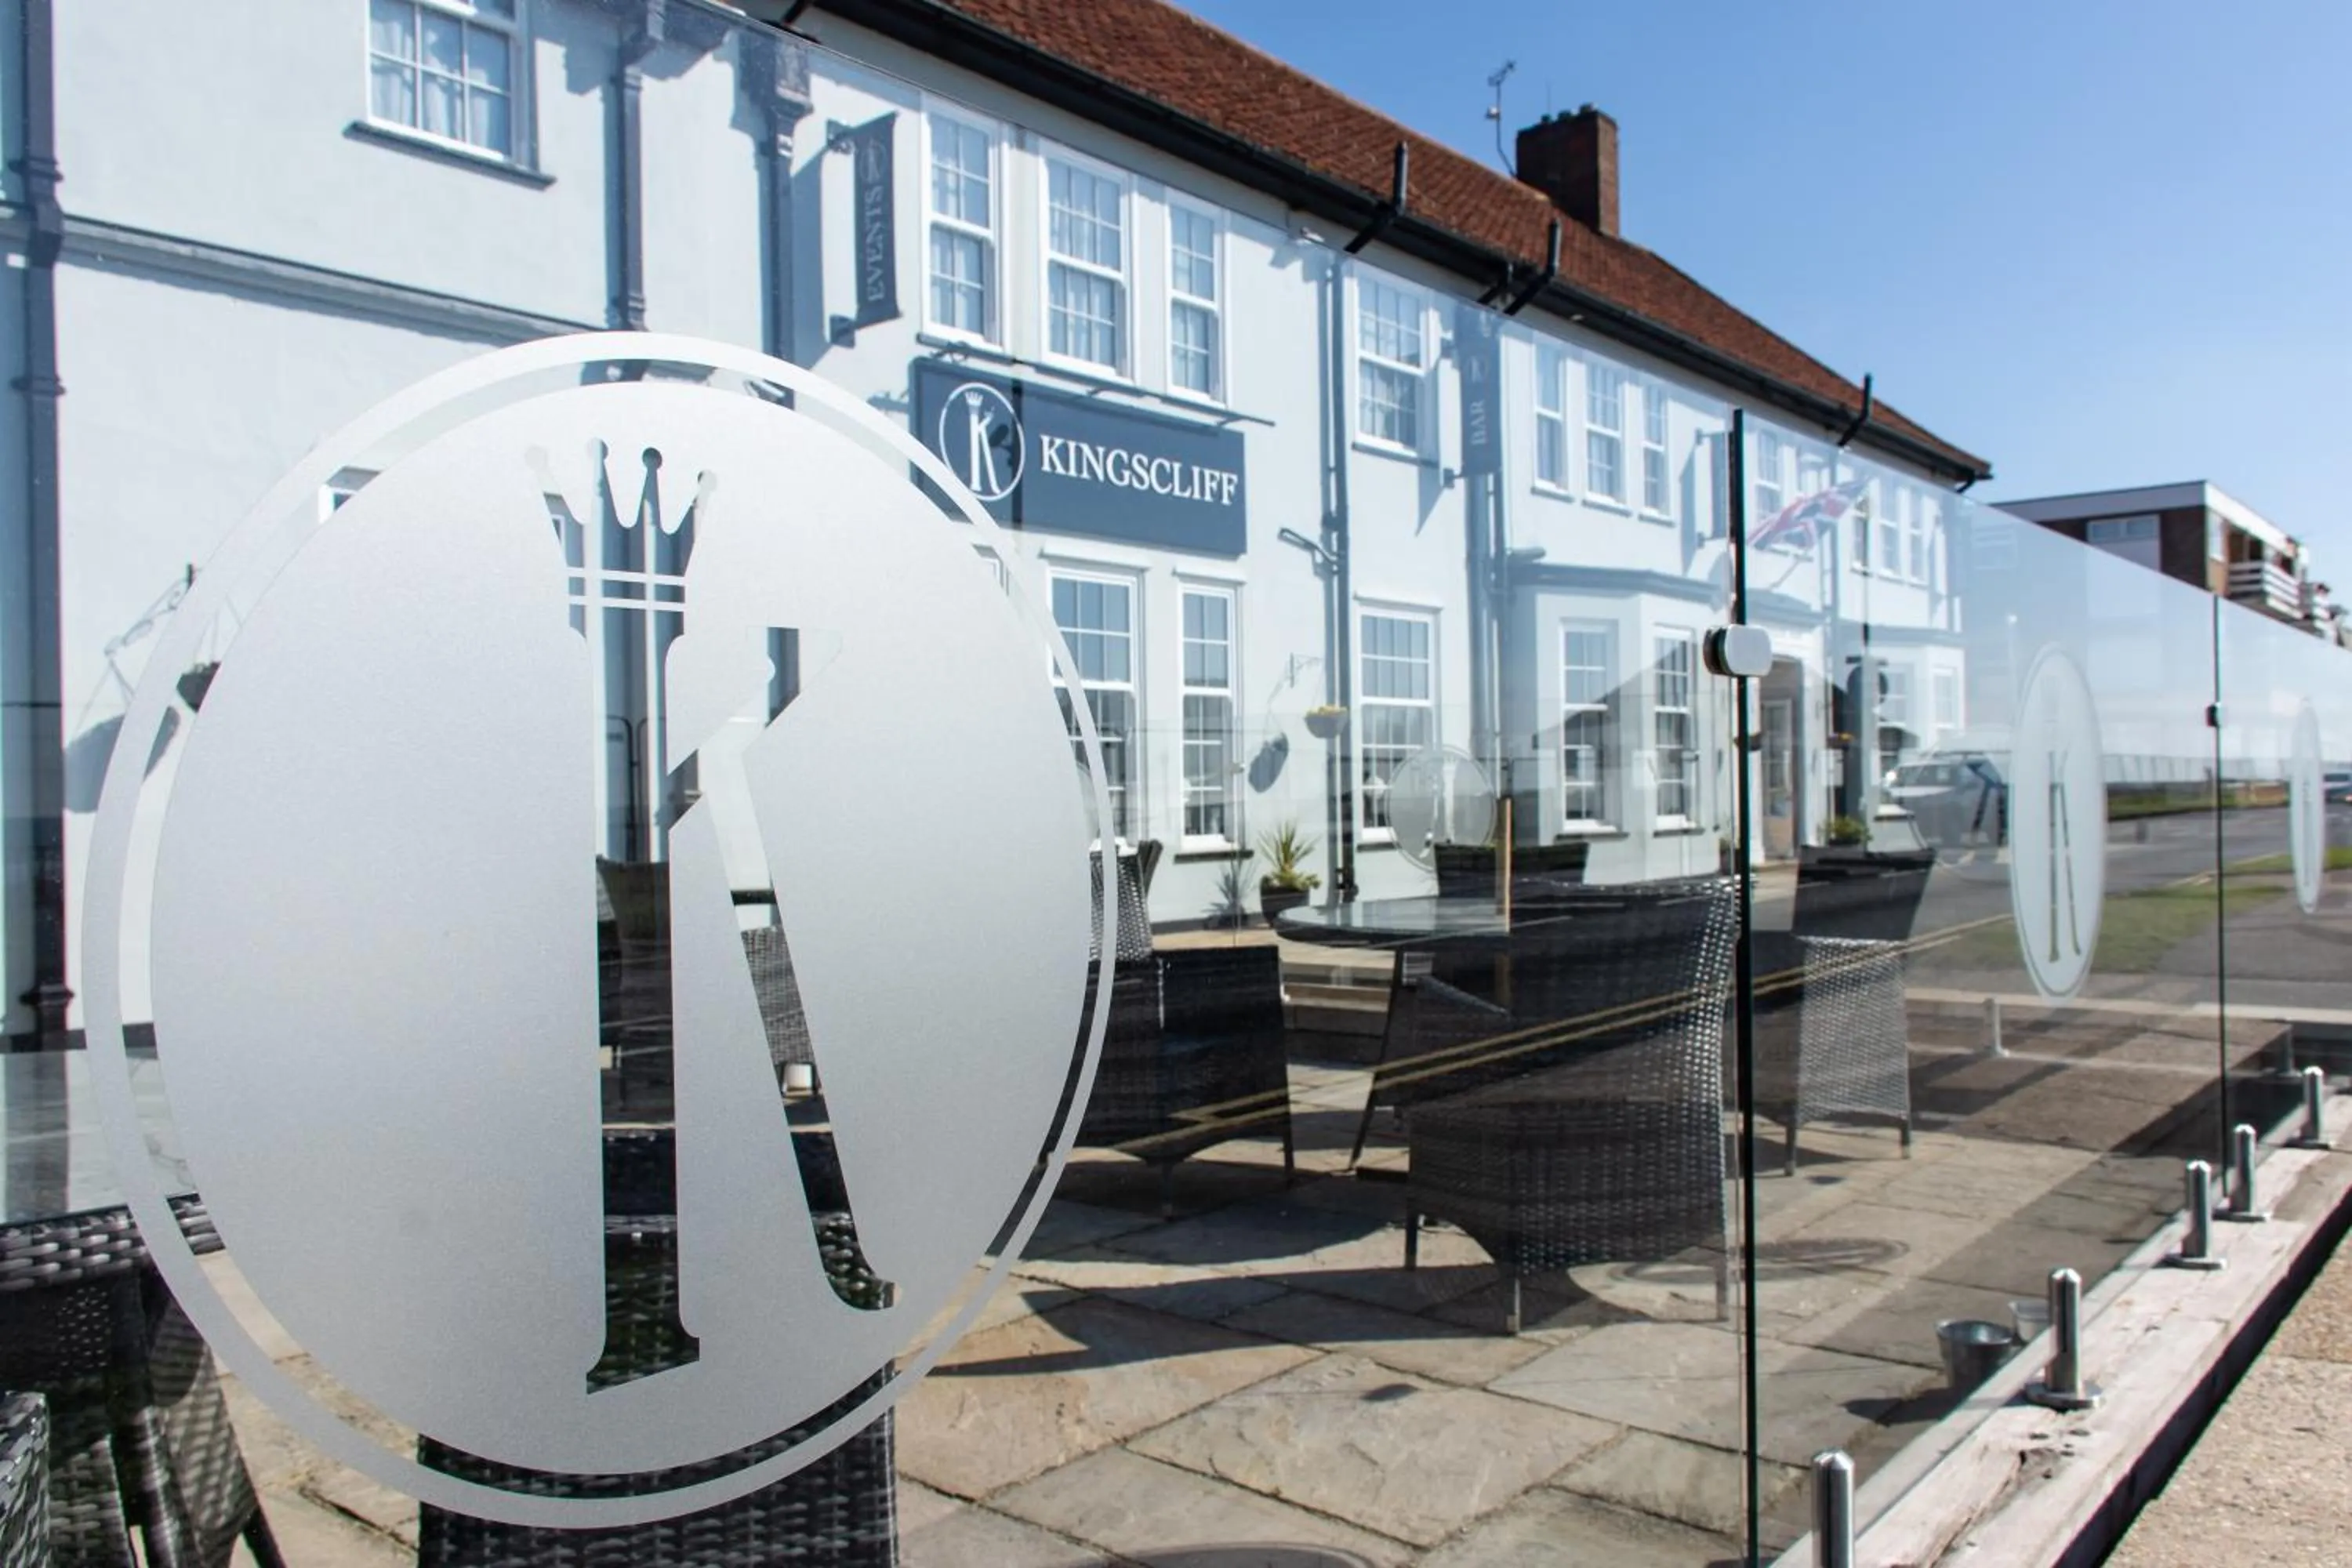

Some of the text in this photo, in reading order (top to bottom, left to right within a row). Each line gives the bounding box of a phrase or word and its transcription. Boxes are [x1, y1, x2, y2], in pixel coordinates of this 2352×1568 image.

[866, 186, 884, 301] EVENTS
[1471, 400, 1486, 445] BAR
[1040, 435, 1239, 506] KINGSCLIFF
